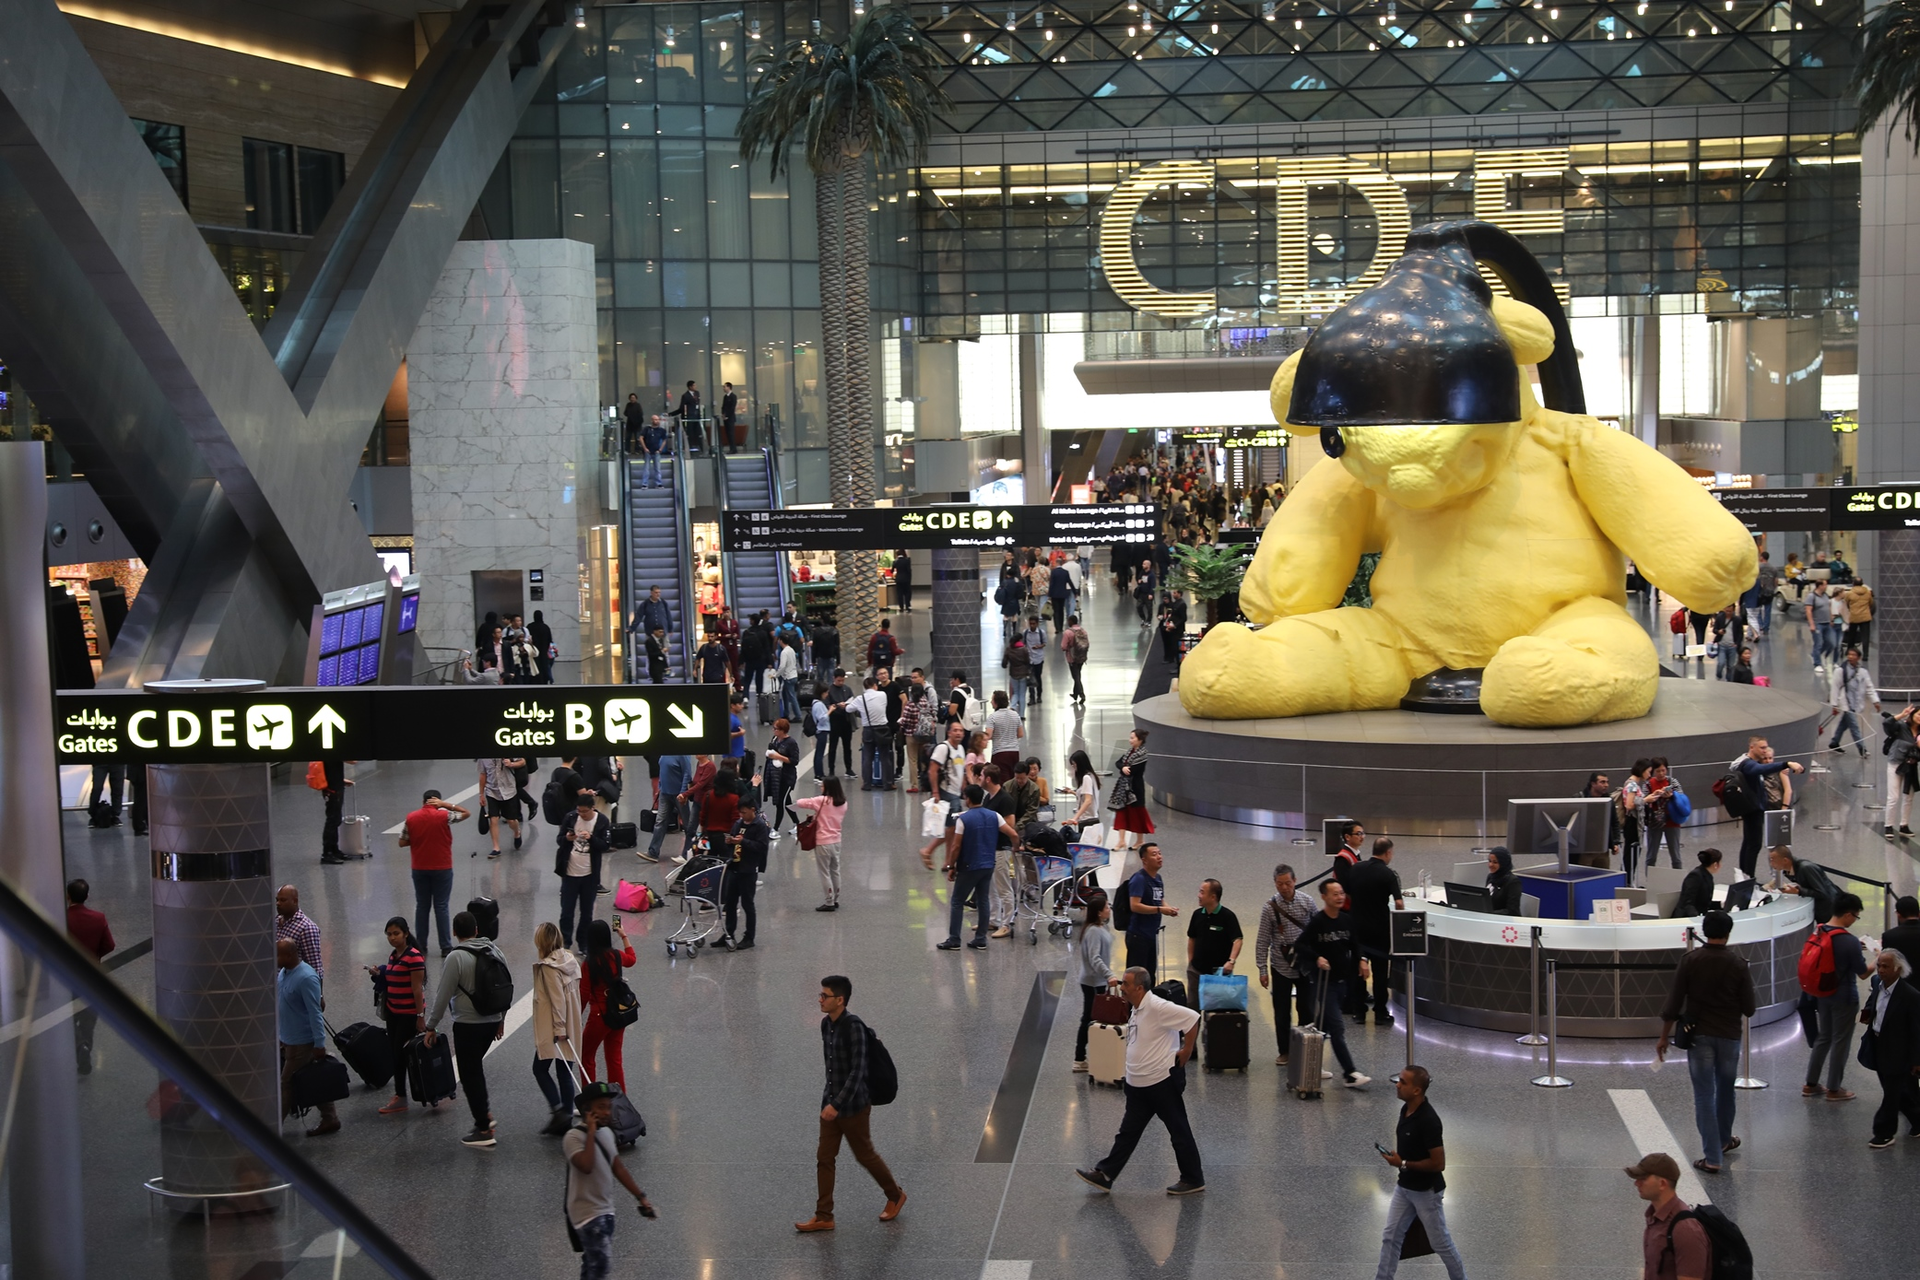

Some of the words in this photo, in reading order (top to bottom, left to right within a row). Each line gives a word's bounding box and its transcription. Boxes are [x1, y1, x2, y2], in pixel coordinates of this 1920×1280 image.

[1847, 502, 1875, 512] Gates
[898, 522, 924, 531] Gates
[66, 708, 117, 728] بوابات
[504, 701, 555, 724] بوابات
[495, 727, 556, 747] Gates
[565, 703, 594, 741] B
[58, 733, 118, 754] Gates
